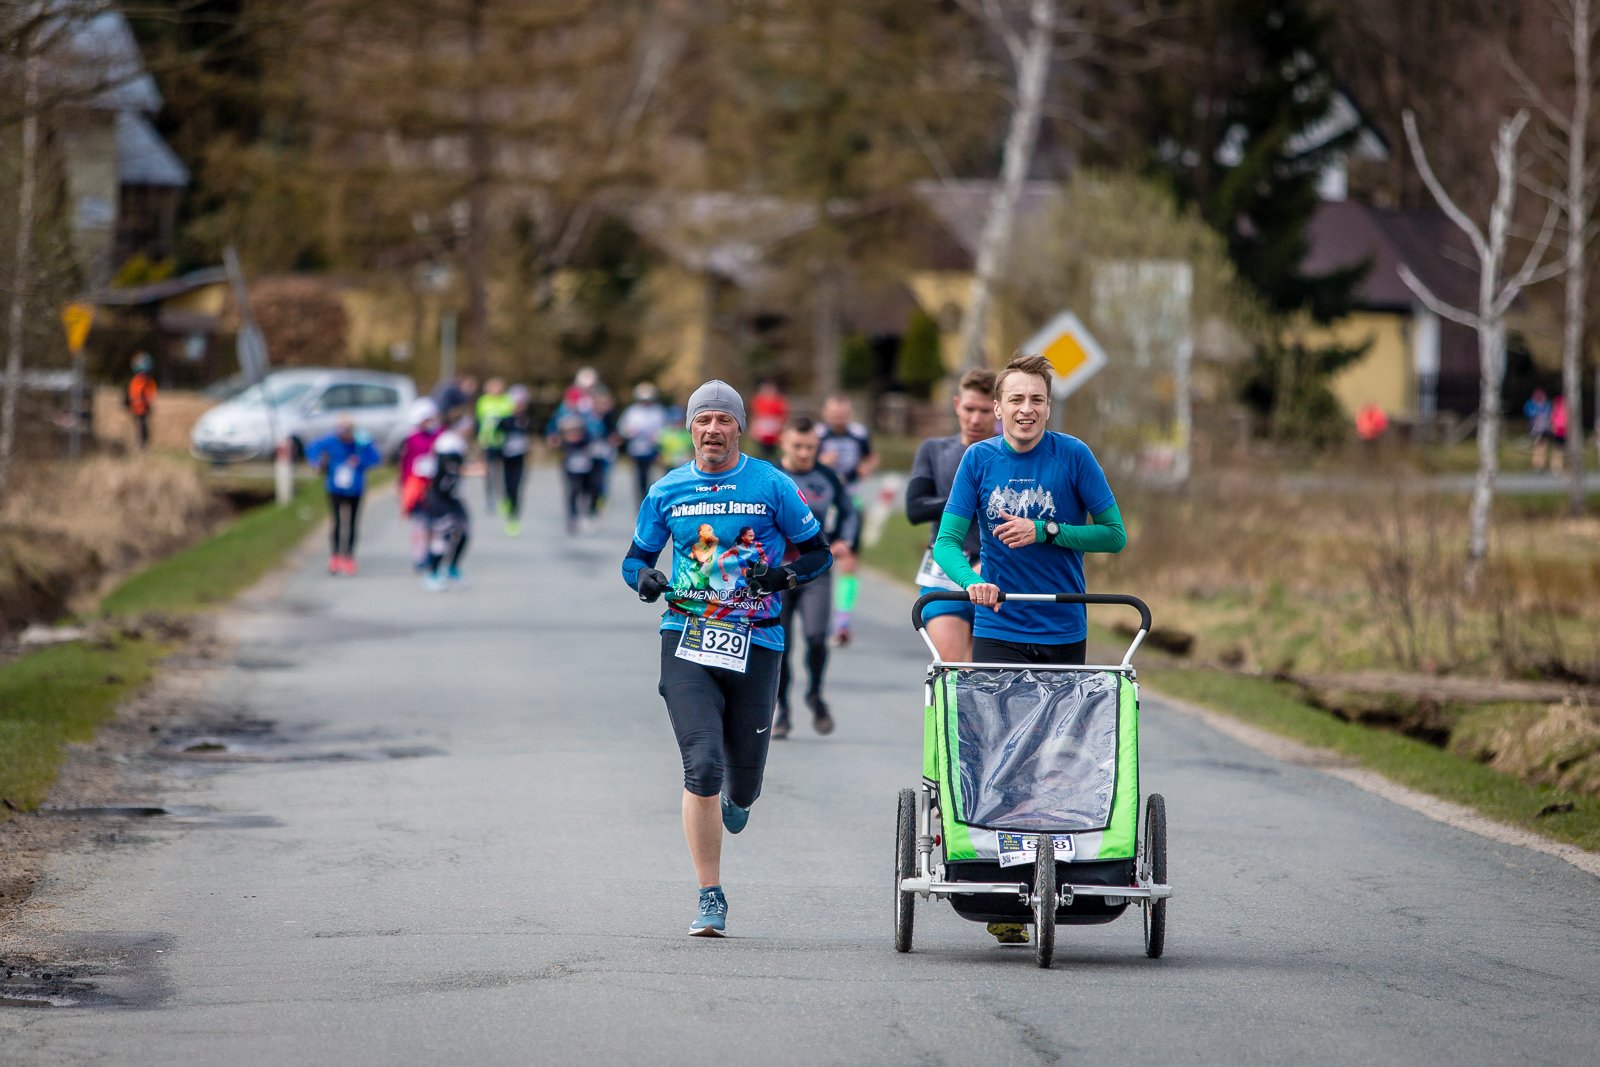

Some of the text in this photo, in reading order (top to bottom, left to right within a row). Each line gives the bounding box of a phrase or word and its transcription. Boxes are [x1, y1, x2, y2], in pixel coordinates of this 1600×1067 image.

[671, 500, 767, 518] Arkadiusz Jaracz
[704, 630, 743, 654] 329
[1026, 840, 1067, 850] 58
